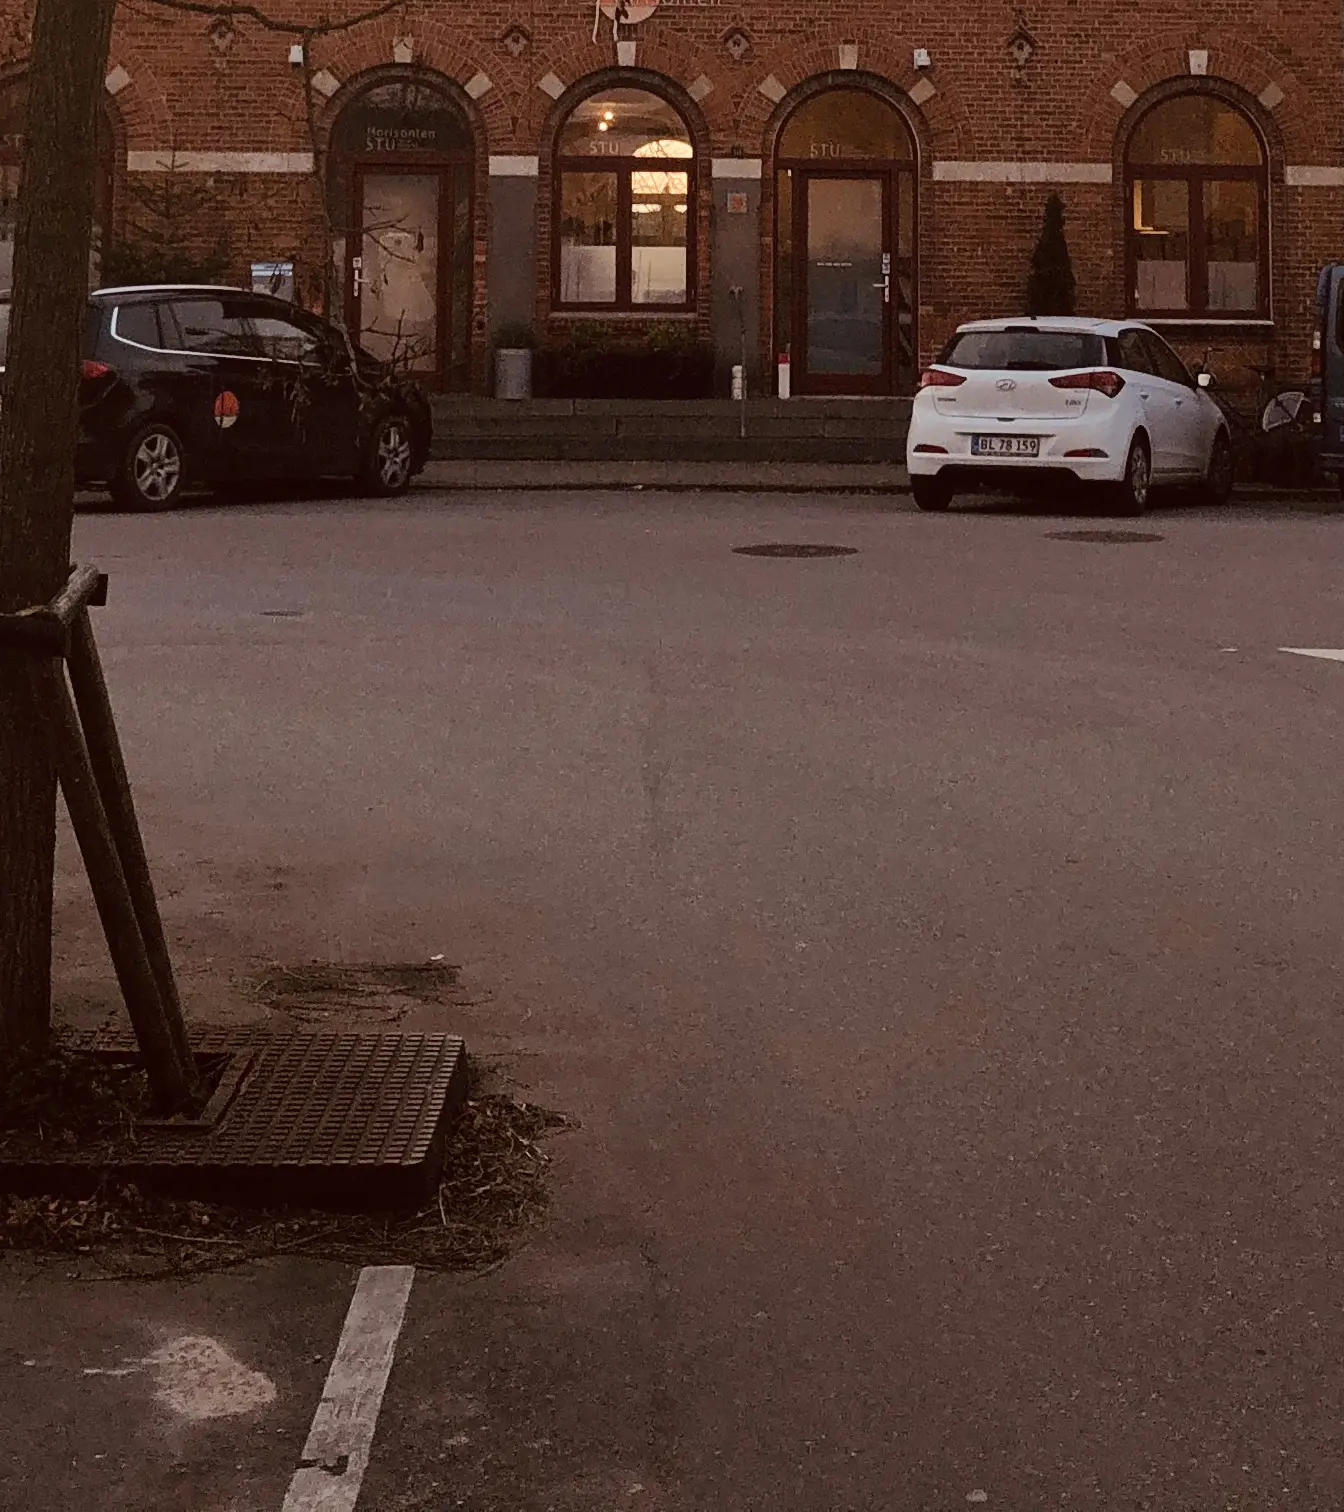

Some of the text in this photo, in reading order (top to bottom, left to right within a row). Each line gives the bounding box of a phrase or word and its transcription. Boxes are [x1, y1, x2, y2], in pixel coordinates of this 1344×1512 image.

[366, 138, 396, 151] STU
[589, 141, 619, 155] STU
[810, 143, 840, 158] STU
[980, 438, 1037, 453] BL 78 159
